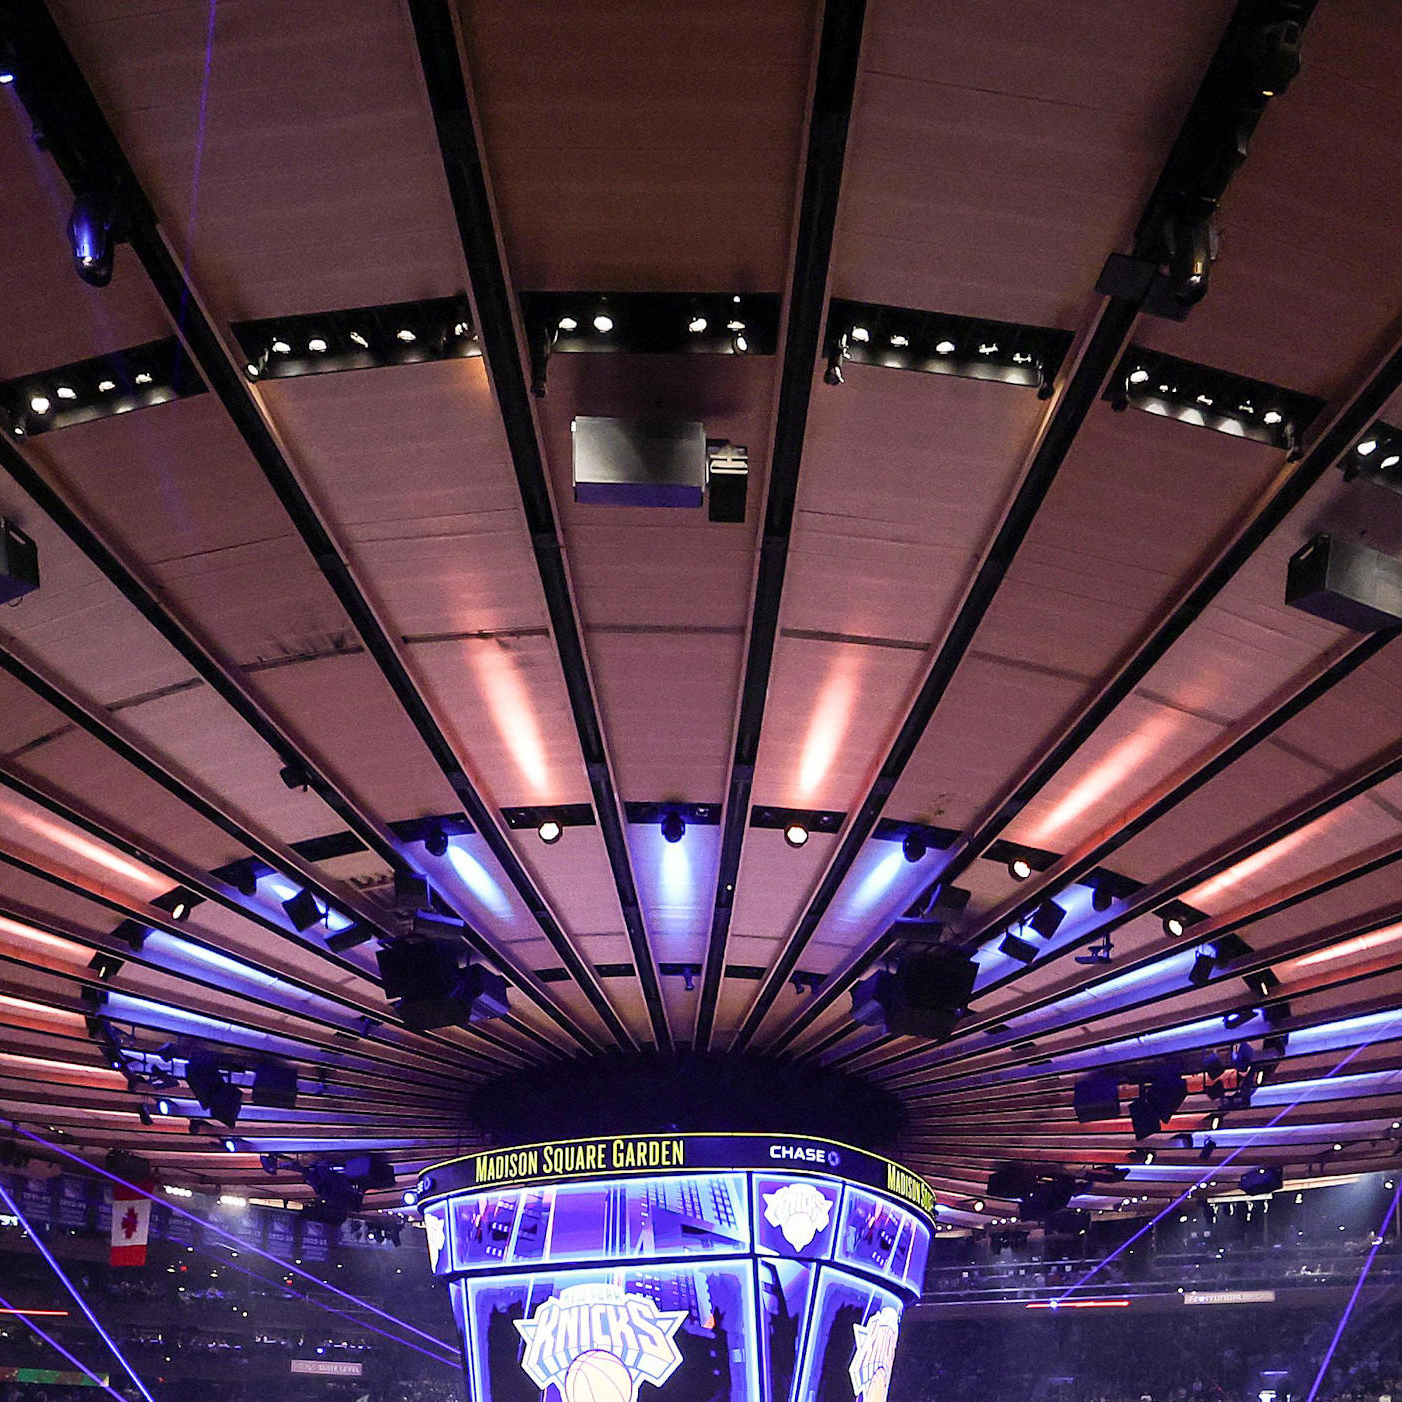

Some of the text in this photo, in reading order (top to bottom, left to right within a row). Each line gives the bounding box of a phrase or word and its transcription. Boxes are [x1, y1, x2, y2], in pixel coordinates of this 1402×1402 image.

[476, 1139, 685, 1183] MADISON SQUARE GARDEN
[769, 1145, 826, 1163] CHASE
[887, 1162, 921, 1205] MADISON
[527, 1300, 677, 1368] KNICKS
